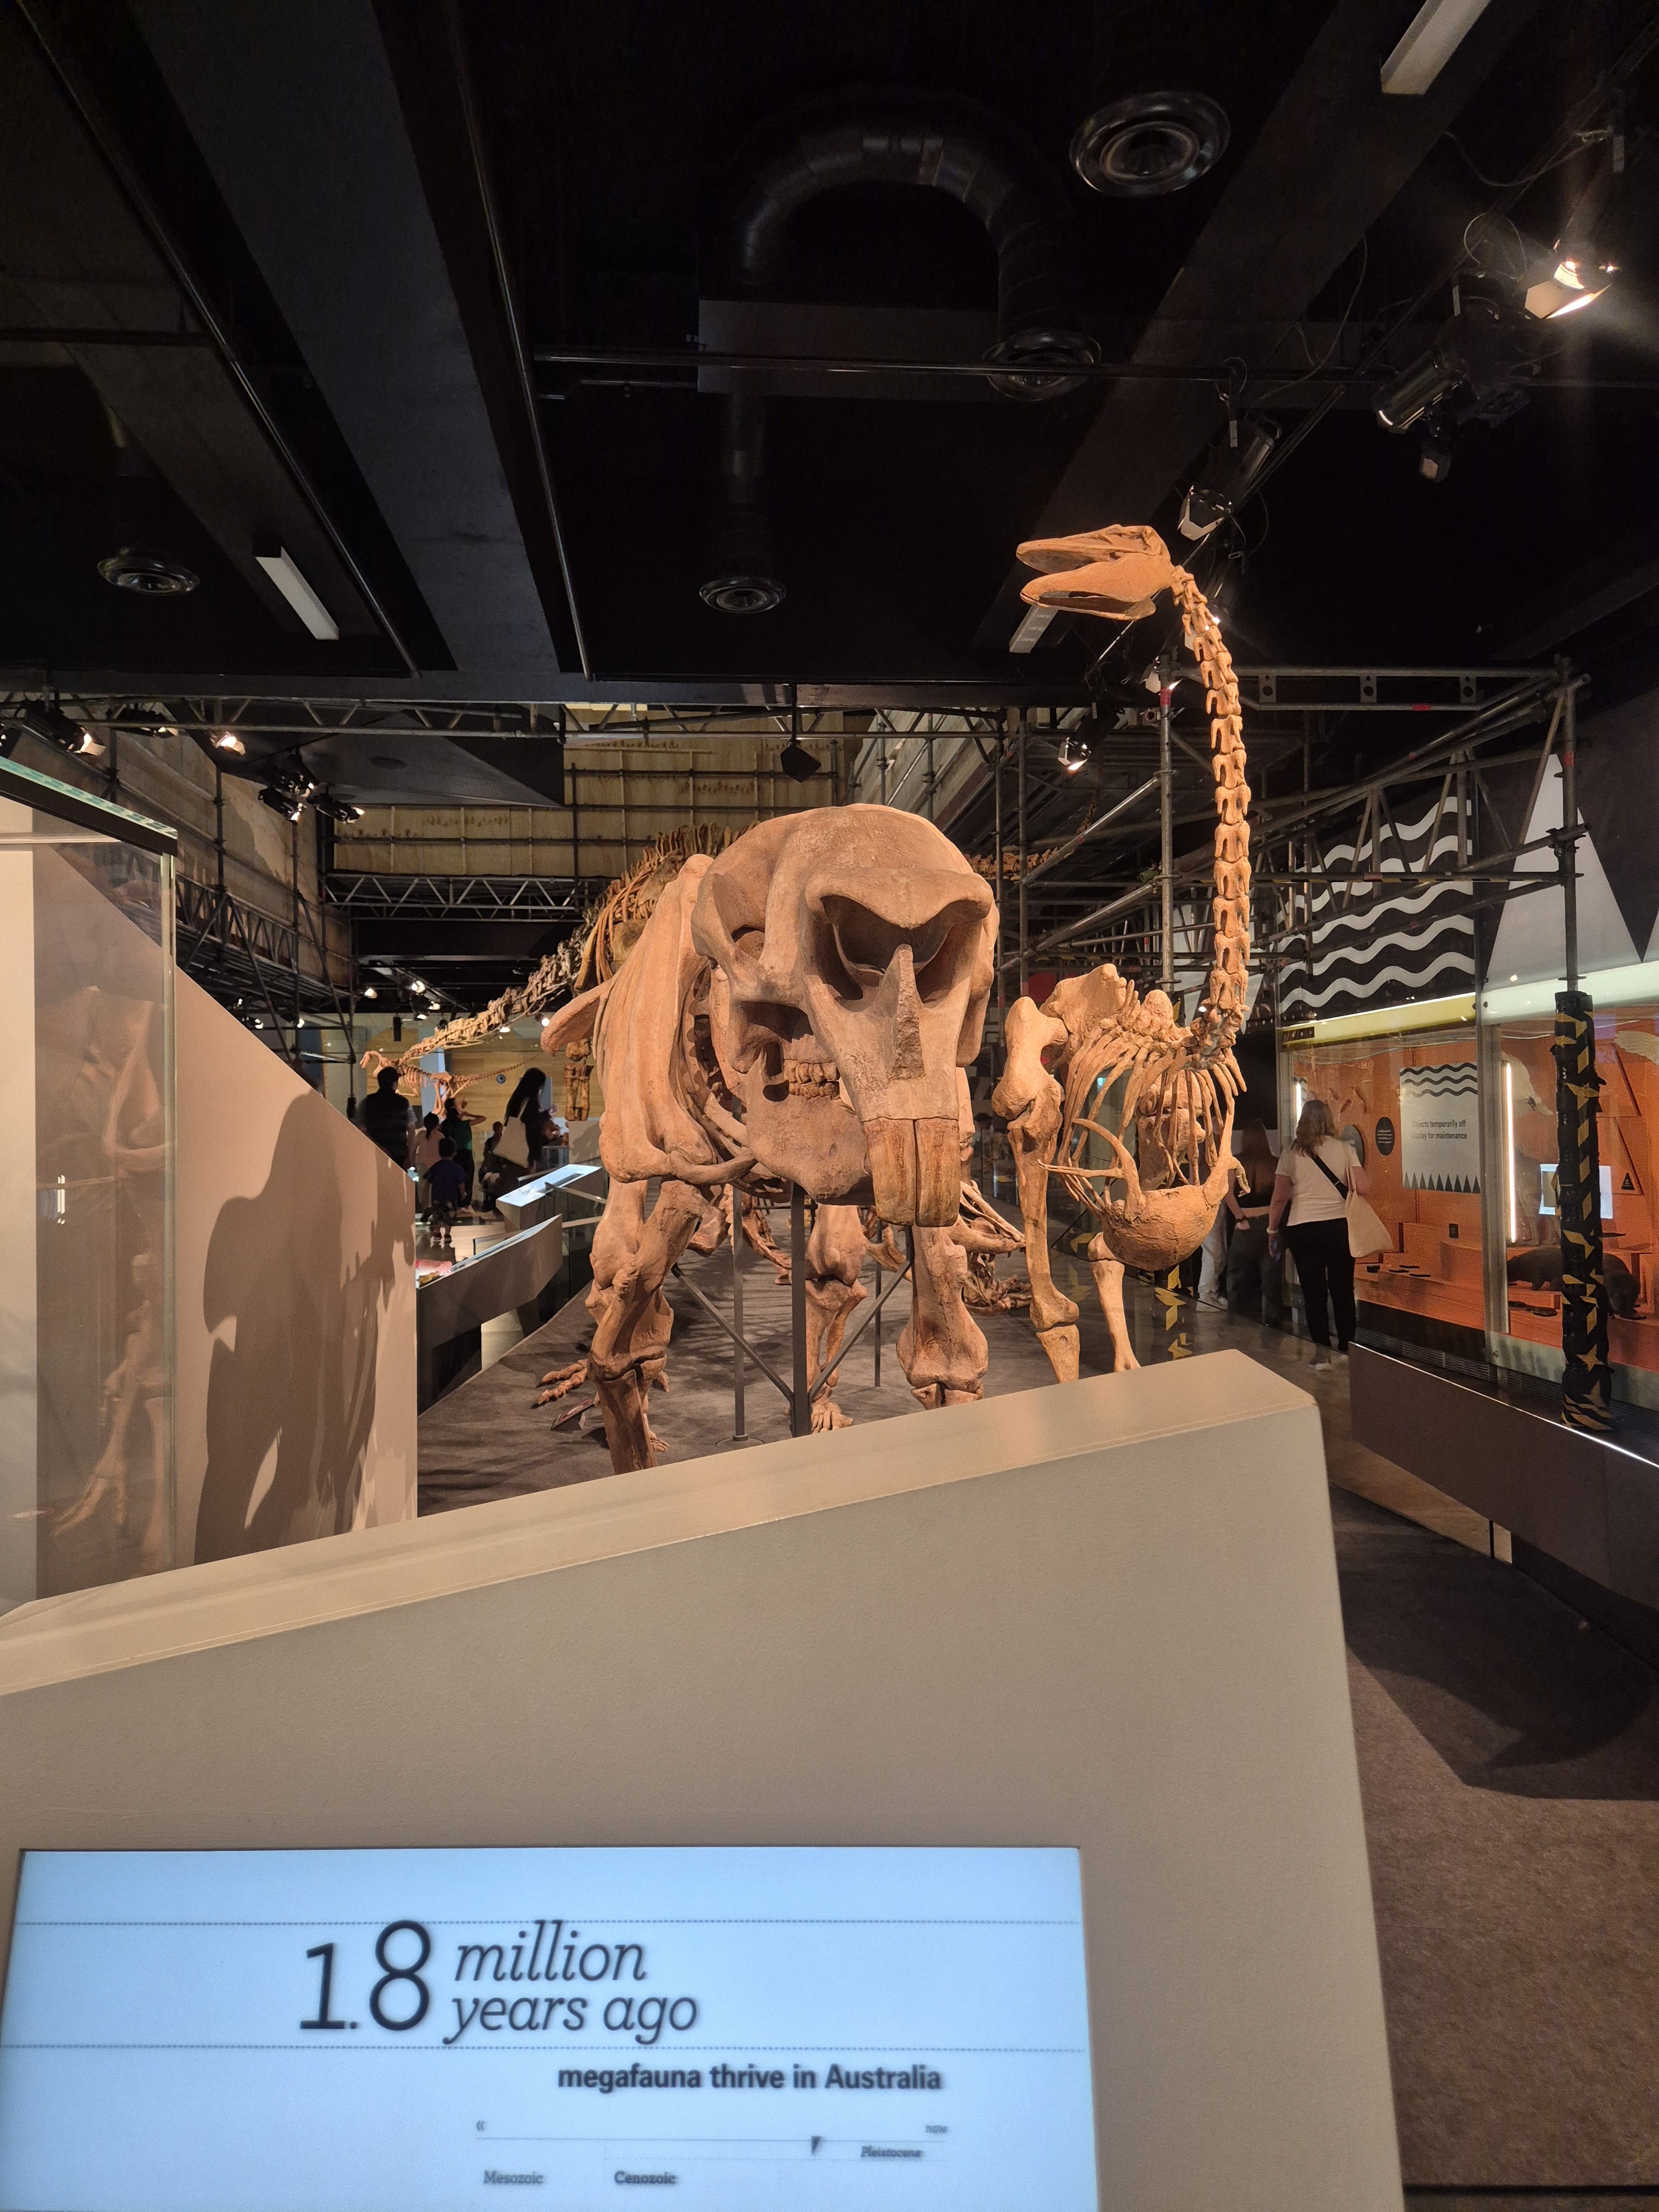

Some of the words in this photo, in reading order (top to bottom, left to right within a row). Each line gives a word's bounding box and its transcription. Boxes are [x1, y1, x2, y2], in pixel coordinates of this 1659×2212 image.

[1412, 1120, 1429, 1129] Objects
[1430, 1119, 1458, 1129] temporarily
[1412, 1131, 1427, 1140] display
[1436, 1131, 1468, 1139] maintenance
[300, 1919, 431, 2031] 1.8
[455, 1919, 646, 1981] million
[442, 1997, 588, 2045] years
[603, 1997, 698, 2045] ago
[557, 2063, 702, 2094] megafauna
[710, 2063, 785, 2089] thrive
[794, 2063, 816, 2089] in
[826, 2064, 943, 2090] Australia
[925, 2124, 948, 2133] now
[860, 2145, 922, 2157] Pleistocene
[483, 2169, 544, 2185] Mesozoic
[614, 2169, 676, 2185] Cenozoic
